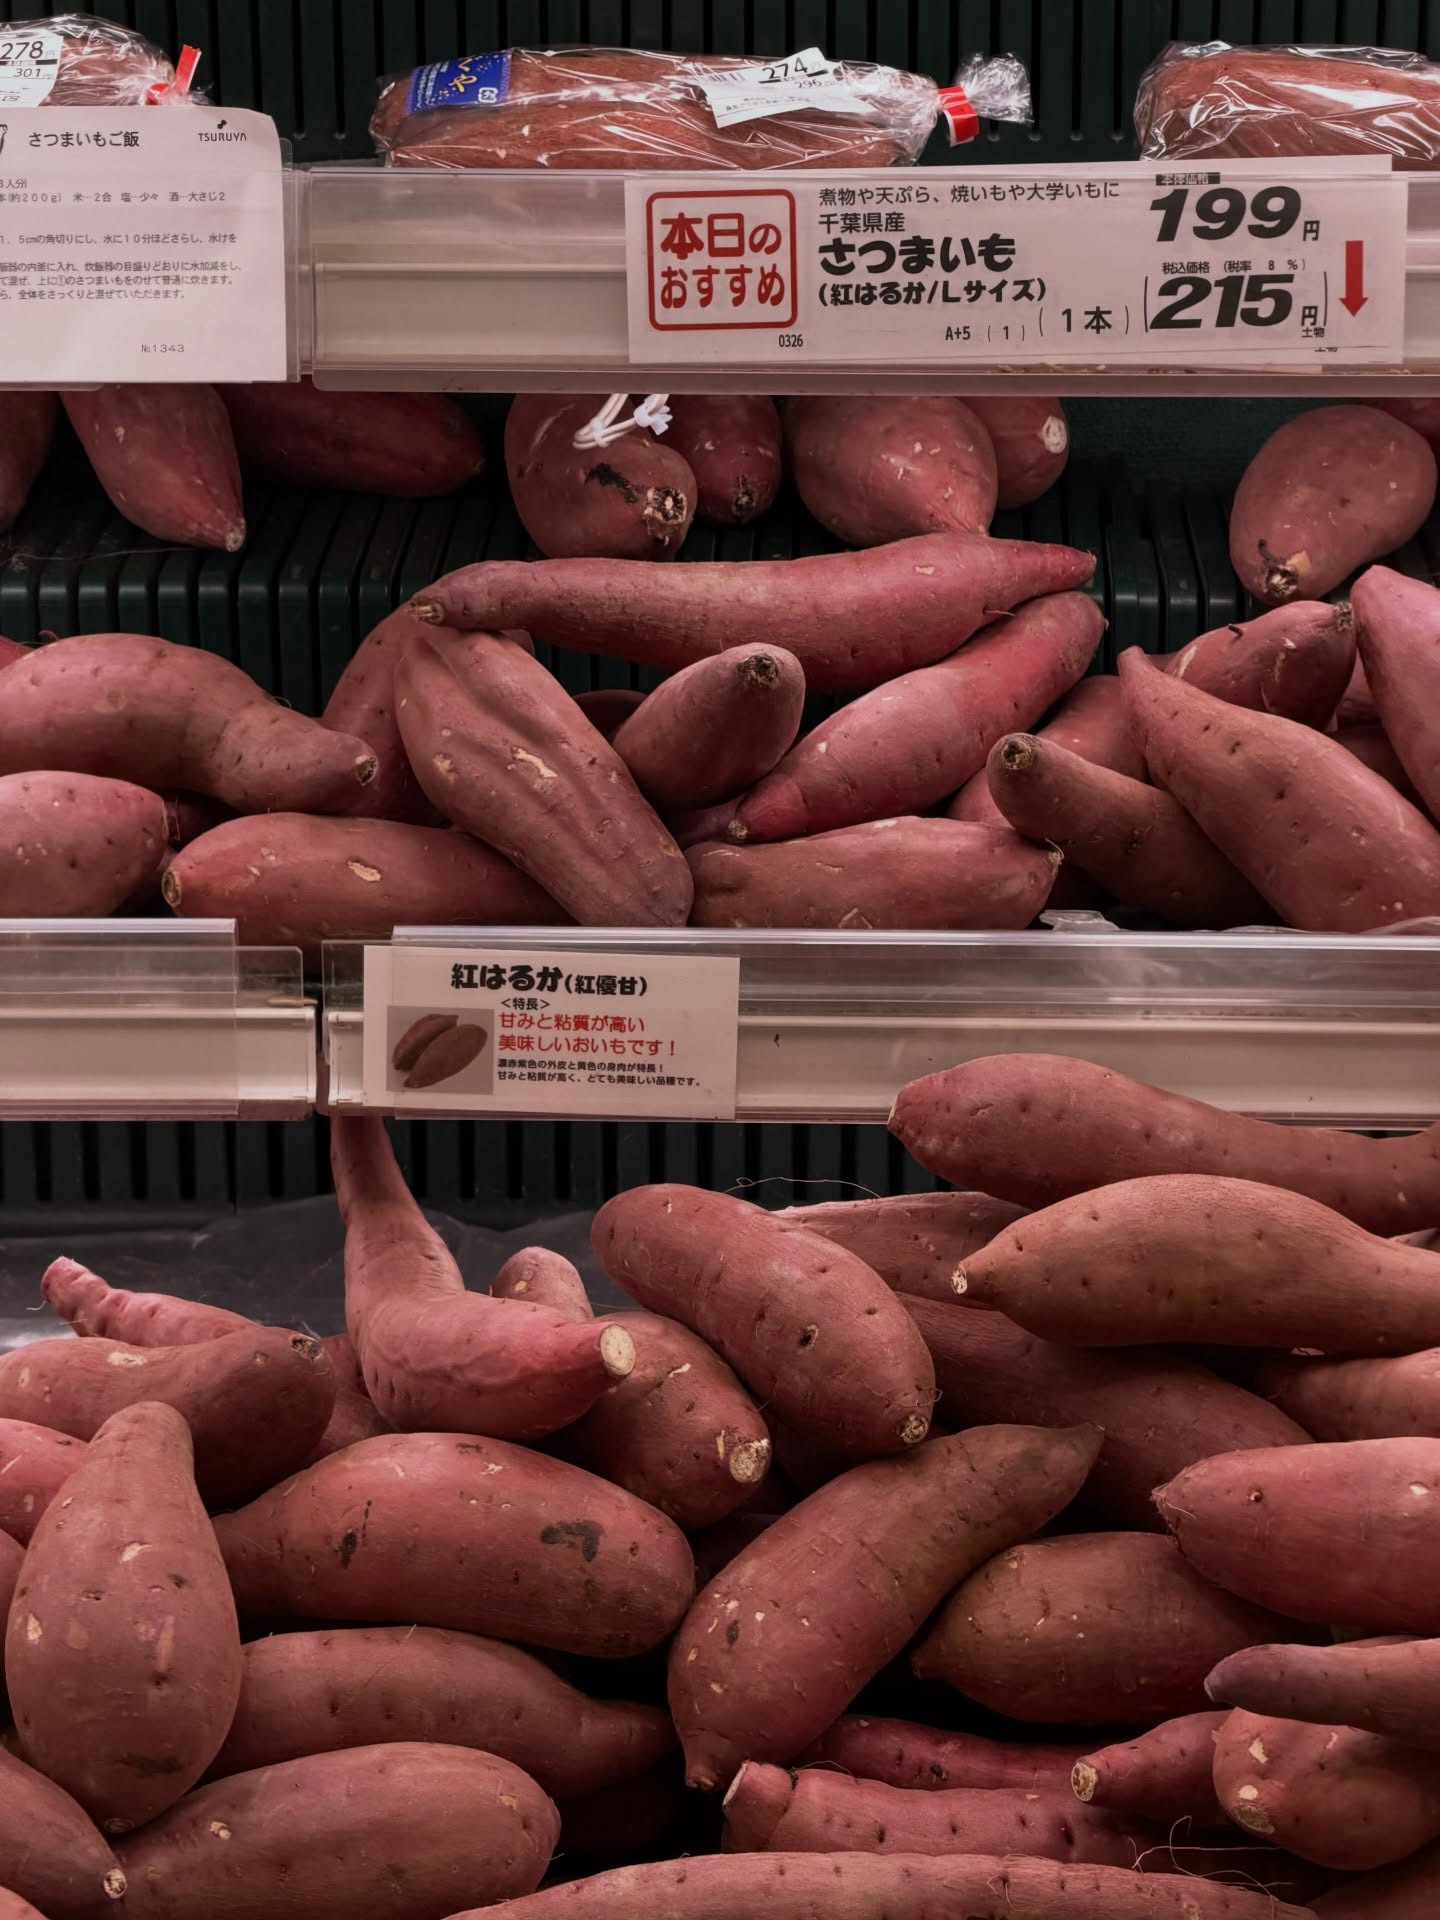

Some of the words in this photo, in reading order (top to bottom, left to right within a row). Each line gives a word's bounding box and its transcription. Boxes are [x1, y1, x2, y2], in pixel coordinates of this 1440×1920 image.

[0, 41, 43, 60] 278
[15, 68, 41, 78] 301
[762, 57, 809, 79] 274
[796, 79, 823, 89] 296
[28, 130, 140, 148] さつまいもご飯
[198, 132, 247, 142] TSURUYA
[819, 181, 1120, 206] 煮物や天ぷら、焼いもや大学いもに
[818, 211, 906, 234] 千葉県産
[660, 212, 783, 260] 本日の
[818, 233, 1016, 276] さつまいも
[1162, 261, 1209, 275] 税込価格
[660, 263, 785, 309] おすすめ
[818, 276, 1047, 308] (紅はるか/Lサイズ)
[778, 333, 804, 348] 0326
[945, 325, 971, 341] A+5
[498, 1012, 645, 1033] 甘みと粘質が高い
[498, 1034, 676, 1058] 美味しいおいもです！
